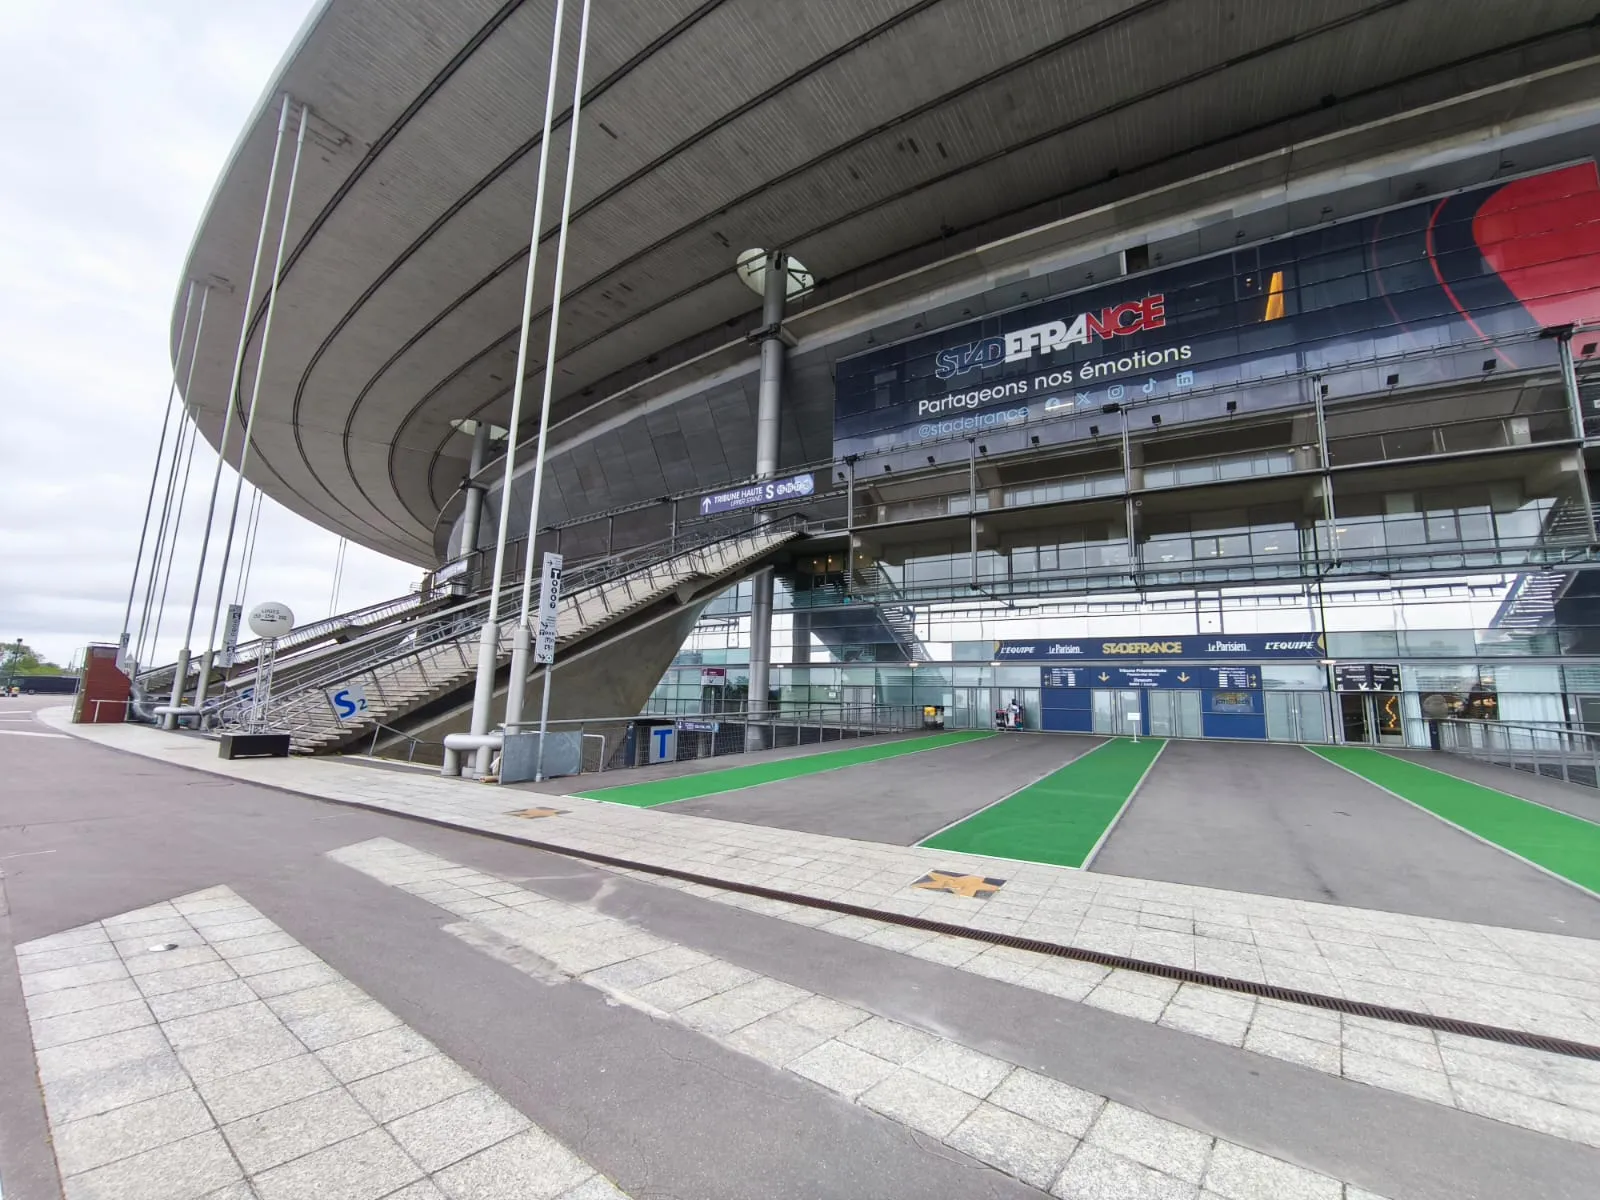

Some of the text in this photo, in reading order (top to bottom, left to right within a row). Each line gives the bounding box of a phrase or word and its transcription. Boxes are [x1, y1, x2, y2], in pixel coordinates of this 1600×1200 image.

[935, 293, 1166, 379] STADEFRANCE
[918, 344, 1192, 416] Partageons nos émotions
[918, 404, 1030, 438] @stadefrance
[714, 491, 740, 504] TRIBUNE
[741, 486, 763, 498] HAUTE
[765, 484, 774, 499] S
[1000, 640, 1314, 654] L'EQUIPE Le Parisien STADEFRANCE Le Parisien L'EQUIPE
[654, 729, 672, 758] T
